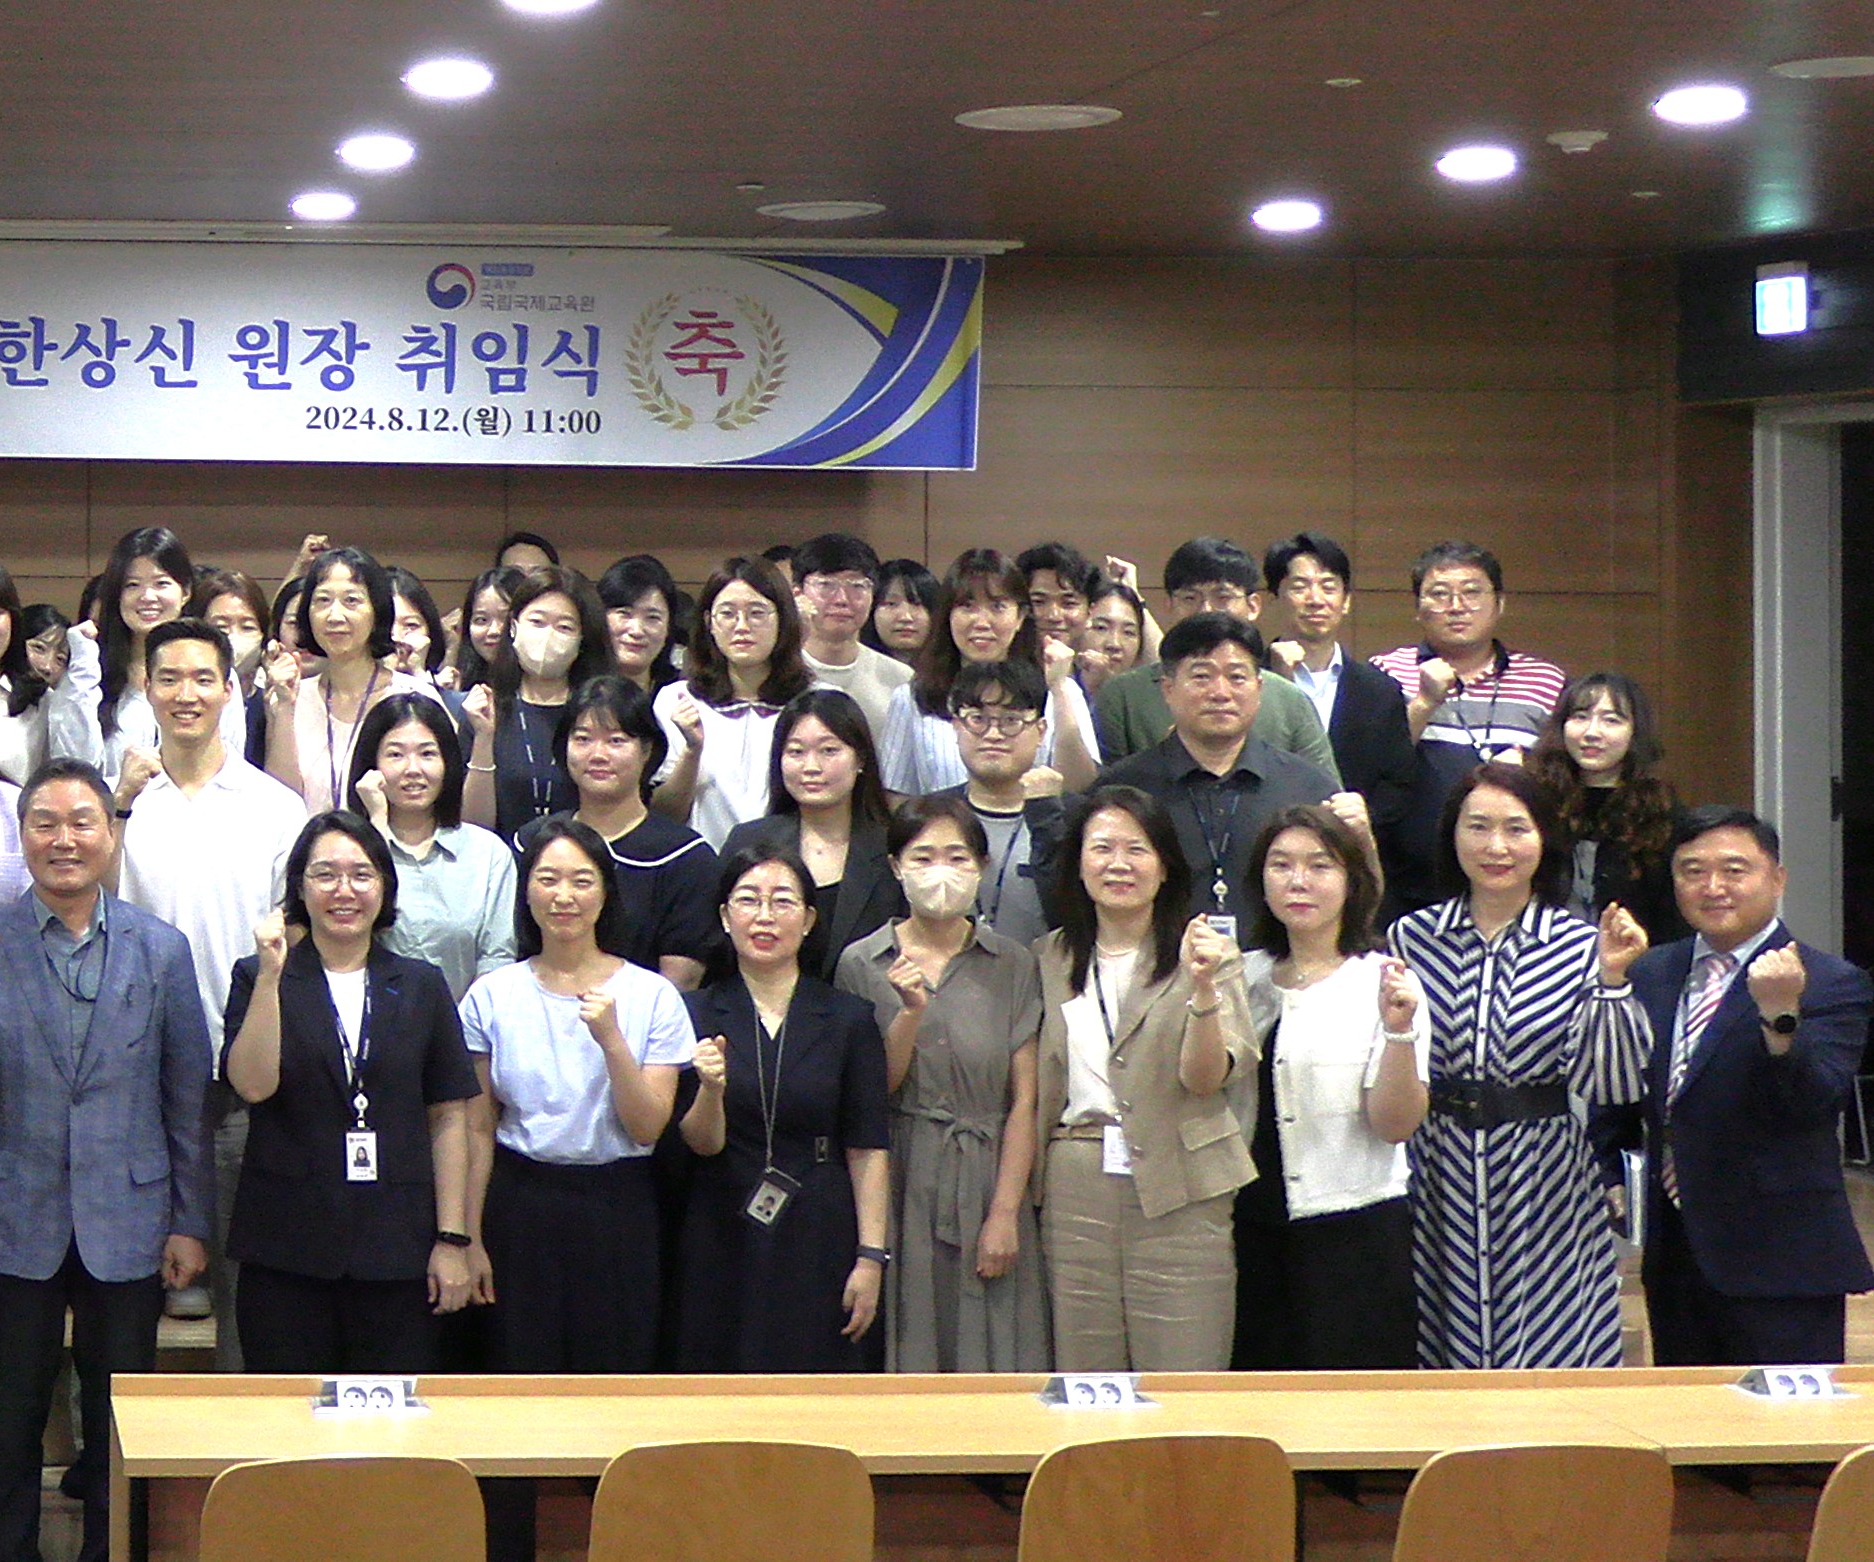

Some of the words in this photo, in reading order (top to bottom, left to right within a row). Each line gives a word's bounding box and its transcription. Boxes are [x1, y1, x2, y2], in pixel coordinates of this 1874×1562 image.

[479, 294, 595, 313] 국립국제교육원
[227, 320, 372, 392] 원장
[395, 321, 601, 396] 취임식
[663, 311, 746, 394] 축
[305, 405, 512, 437] 2024.8.12.(월)
[524, 409, 602, 435] 11:00
